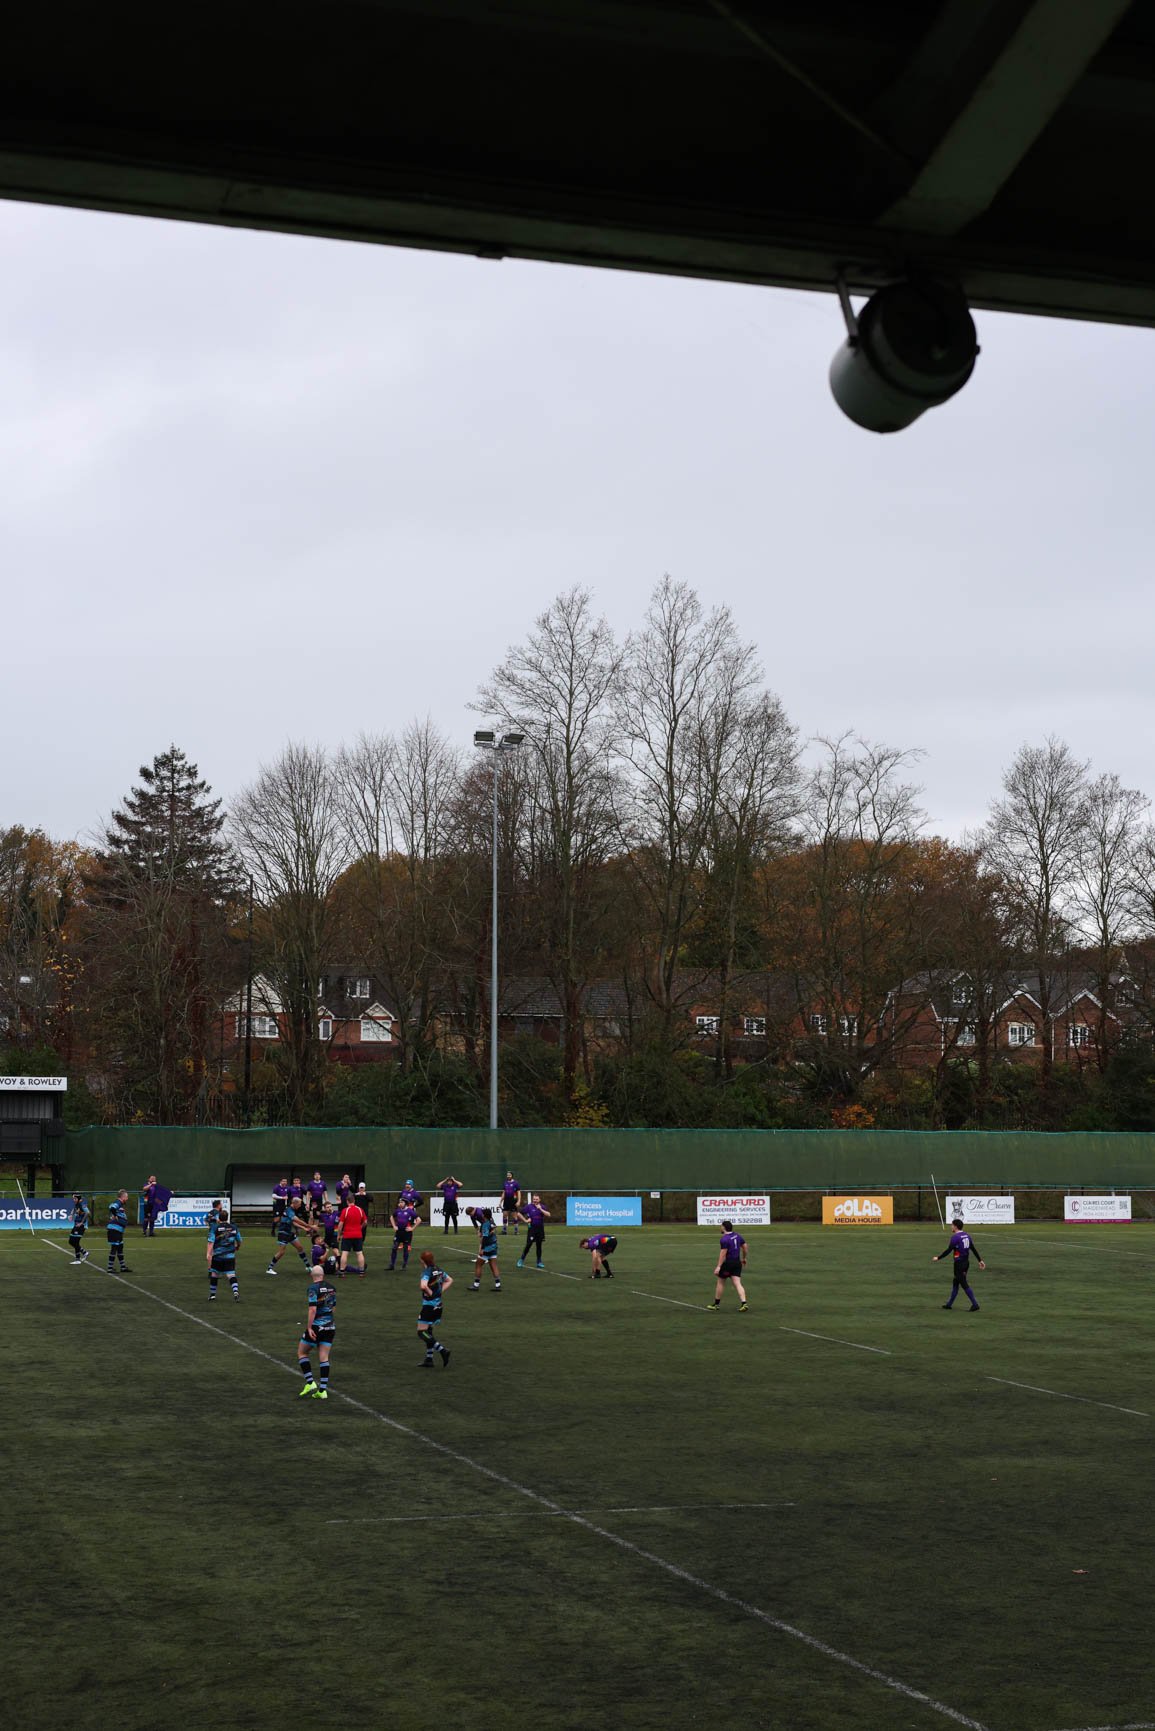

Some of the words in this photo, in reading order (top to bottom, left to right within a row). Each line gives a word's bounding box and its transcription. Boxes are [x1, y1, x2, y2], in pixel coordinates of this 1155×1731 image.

[19, 1078, 26, 1086] &
[28, 1078, 63, 1086] ROWLEY
[702, 1199, 766, 1207] CRAUFURD
[834, 1198, 882, 1217] POLAR
[966, 1198, 986, 1211] The
[574, 1209, 605, 1218] Margaret
[606, 1208, 634, 1217] Hospital
[962, 1238, 970, 1249] 10
